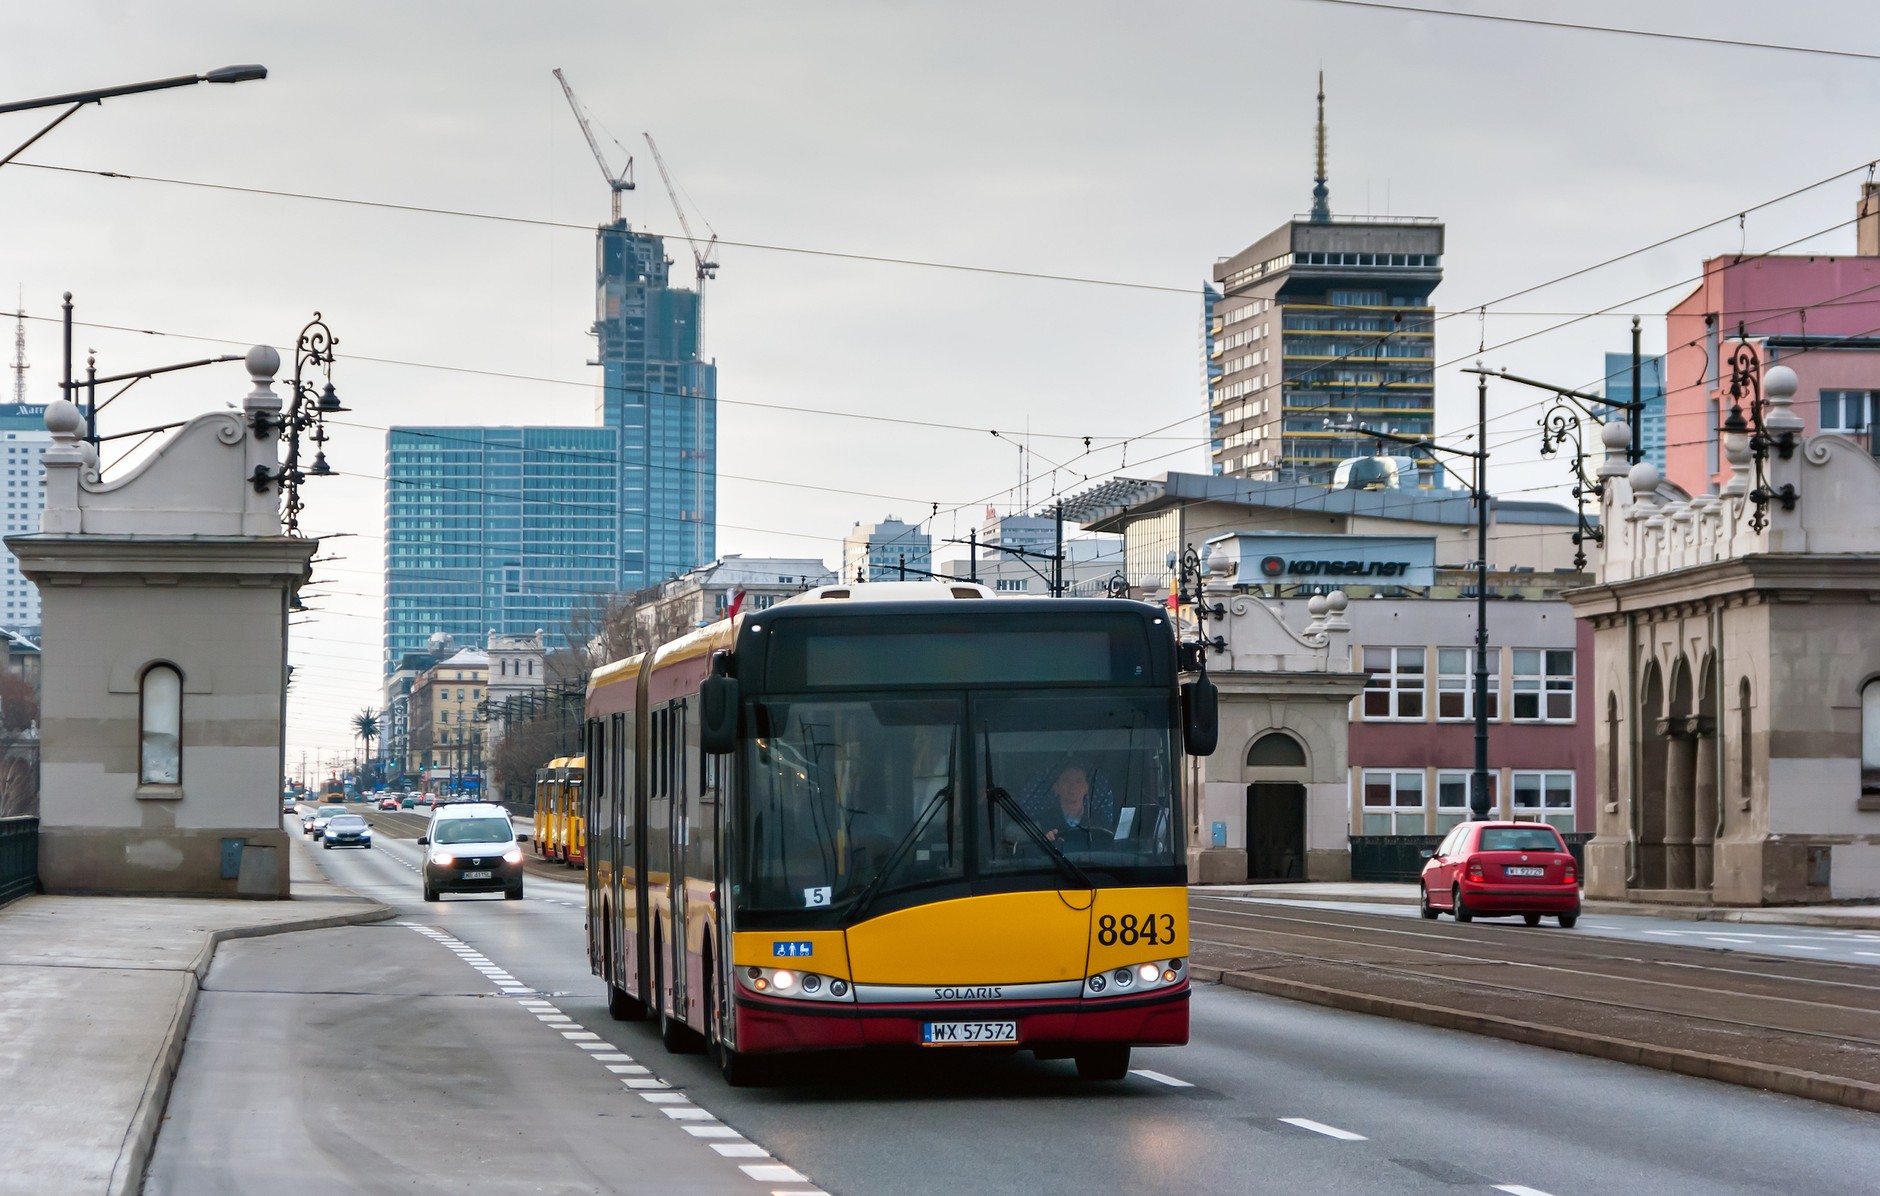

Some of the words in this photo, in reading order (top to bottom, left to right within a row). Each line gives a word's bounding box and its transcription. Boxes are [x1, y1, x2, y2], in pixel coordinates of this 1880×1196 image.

[813, 888, 824, 904] 5
[1098, 913, 1176, 946] 8843
[934, 987, 1002, 1000] SOLARIS
[934, 1024, 957, 1040] WX
[964, 1023, 1014, 1040] 57572
